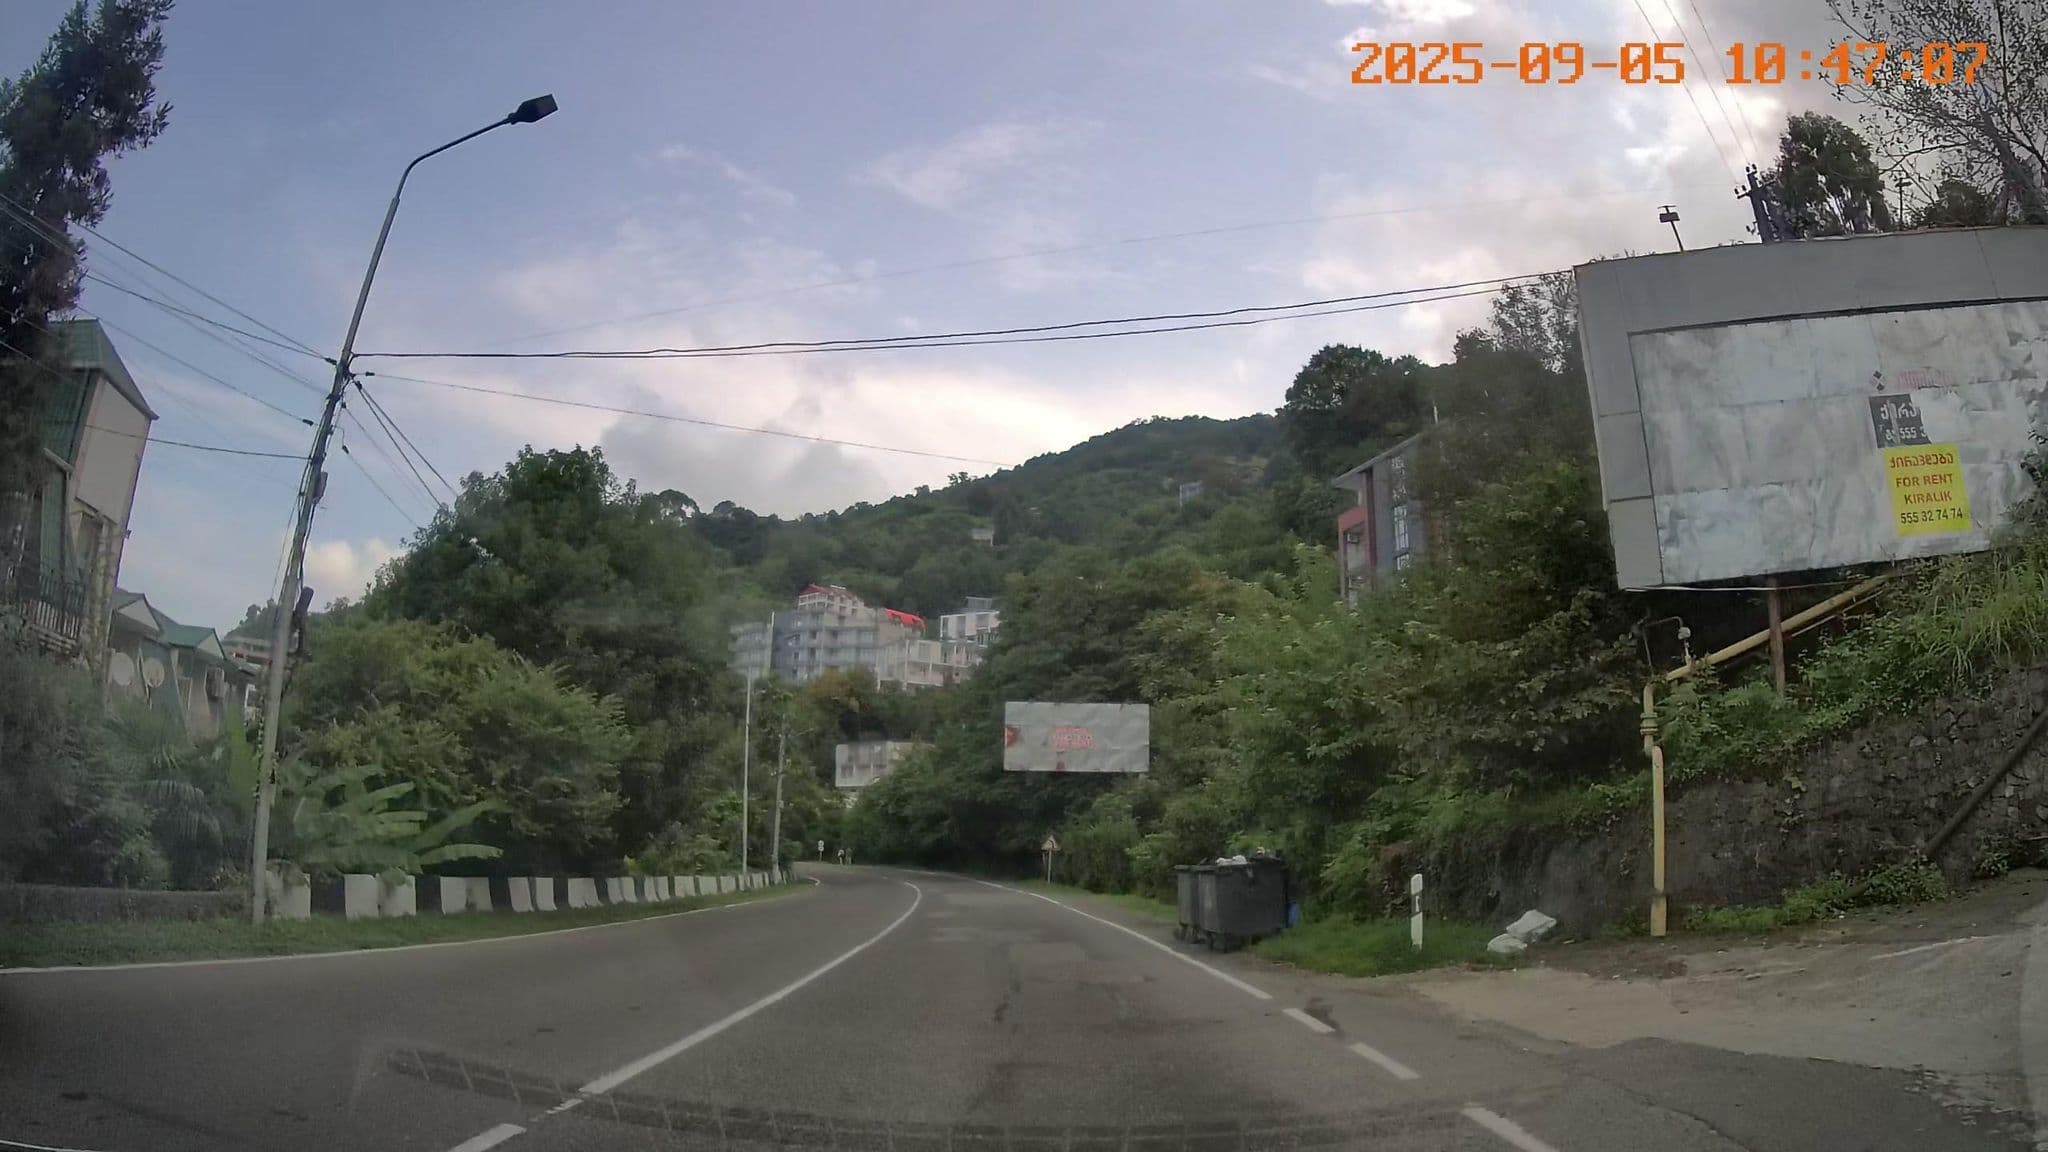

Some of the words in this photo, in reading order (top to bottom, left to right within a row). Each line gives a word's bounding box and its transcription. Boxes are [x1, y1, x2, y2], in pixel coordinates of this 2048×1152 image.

[1896, 476, 1920, 488] FOR
[1923, 473, 1953, 486] RENT
[1904, 490, 1952, 505] KIRALIK
[1900, 511, 1919, 524] 555
[1921, 510, 1934, 522] 32
